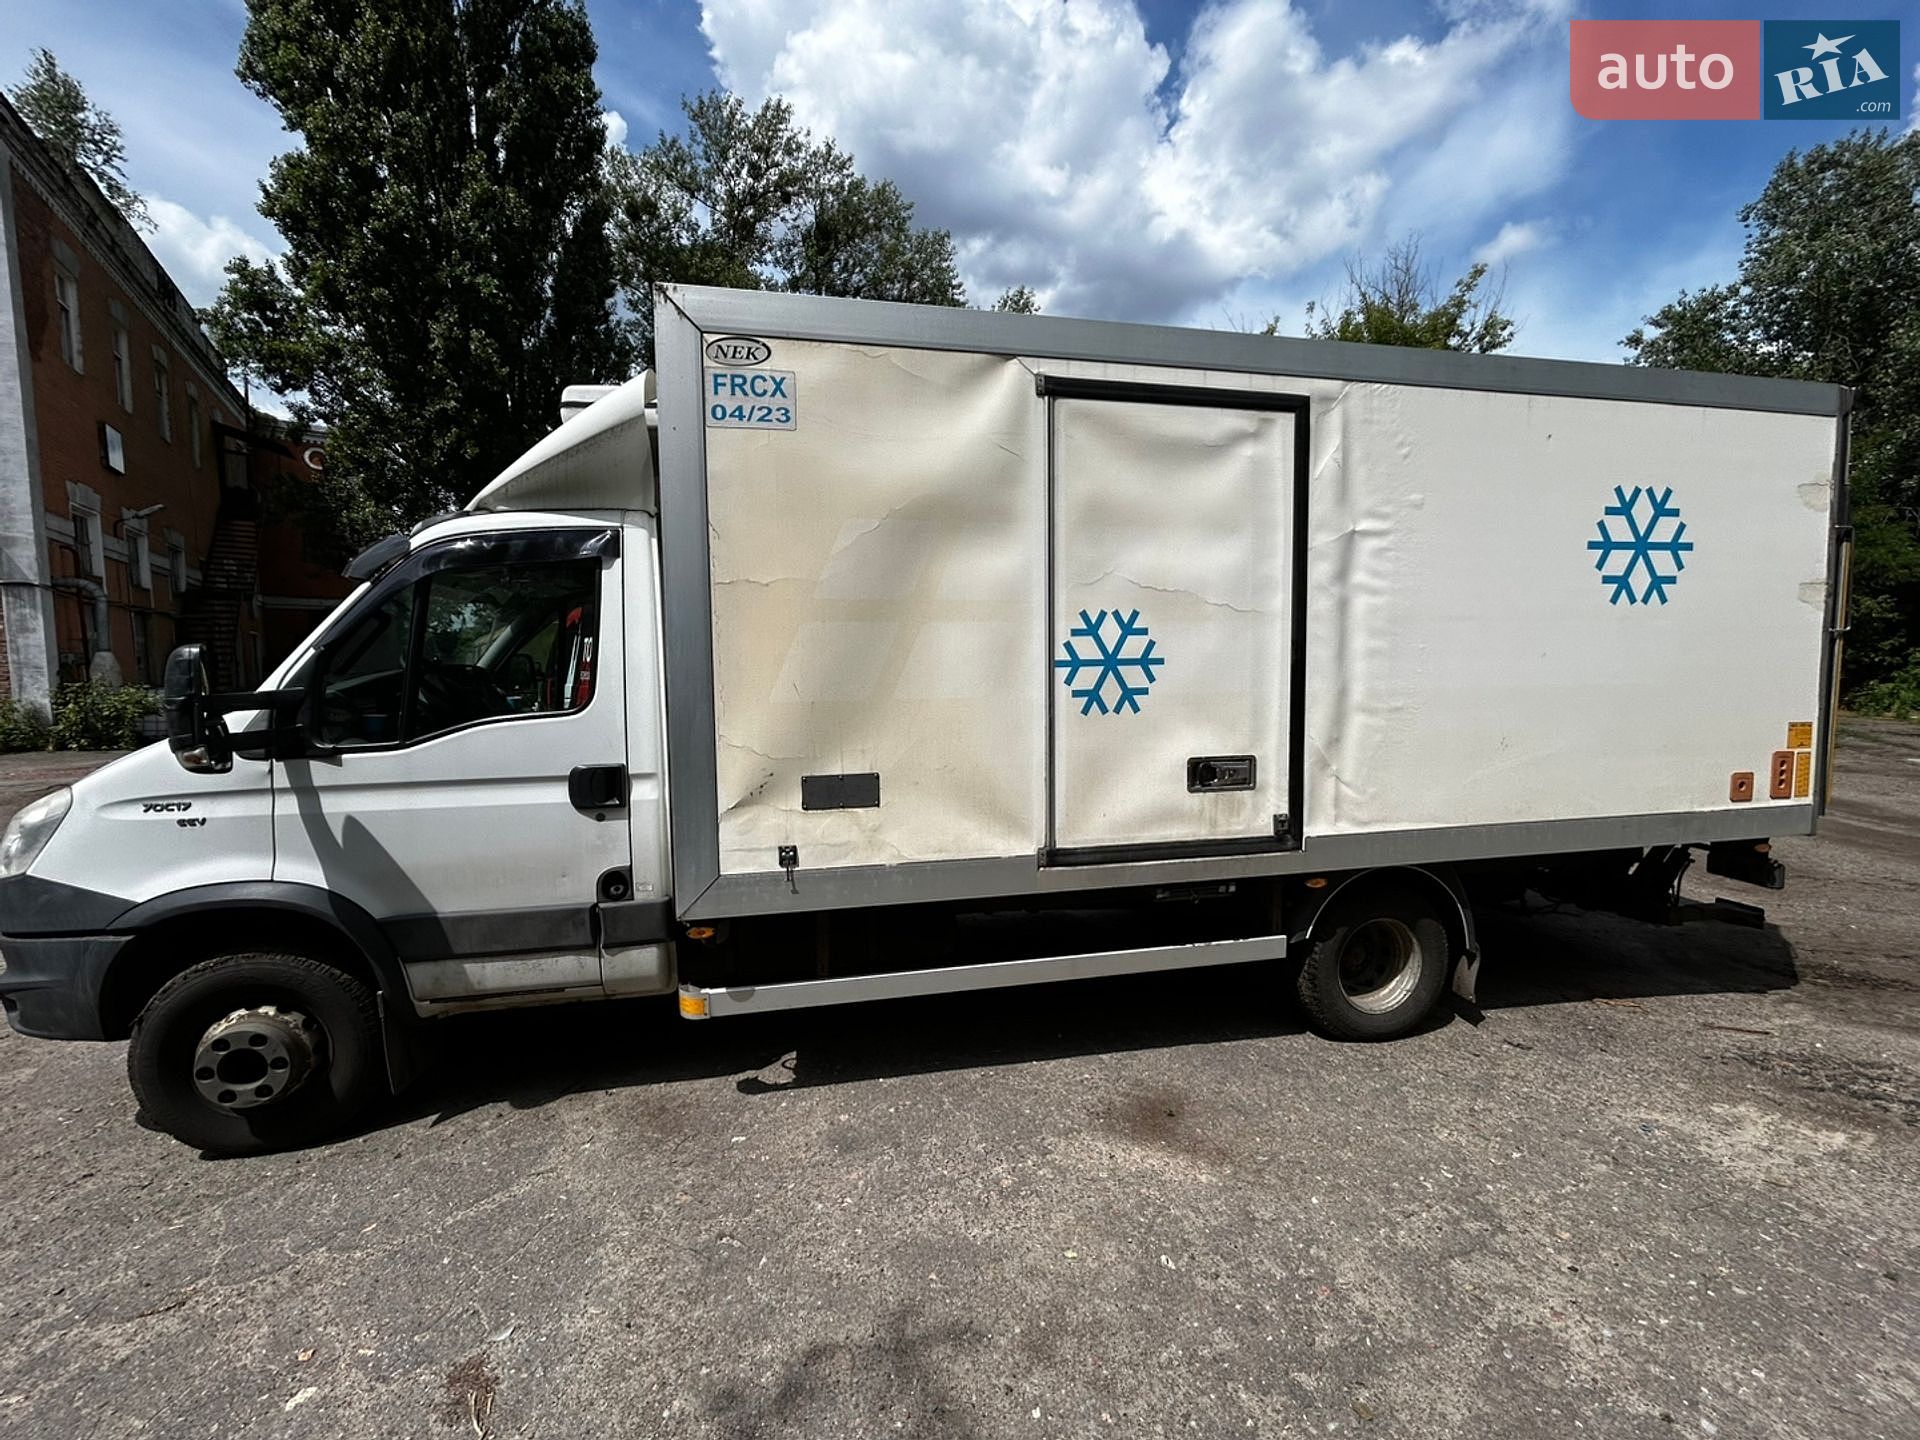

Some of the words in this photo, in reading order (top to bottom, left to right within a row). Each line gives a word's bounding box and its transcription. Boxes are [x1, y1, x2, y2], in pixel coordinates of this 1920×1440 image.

[714, 344, 761, 361] NEK
[712, 373, 787, 399] FRCX
[710, 404, 791, 423] 04/23
[142, 802, 192, 813] 70C17
